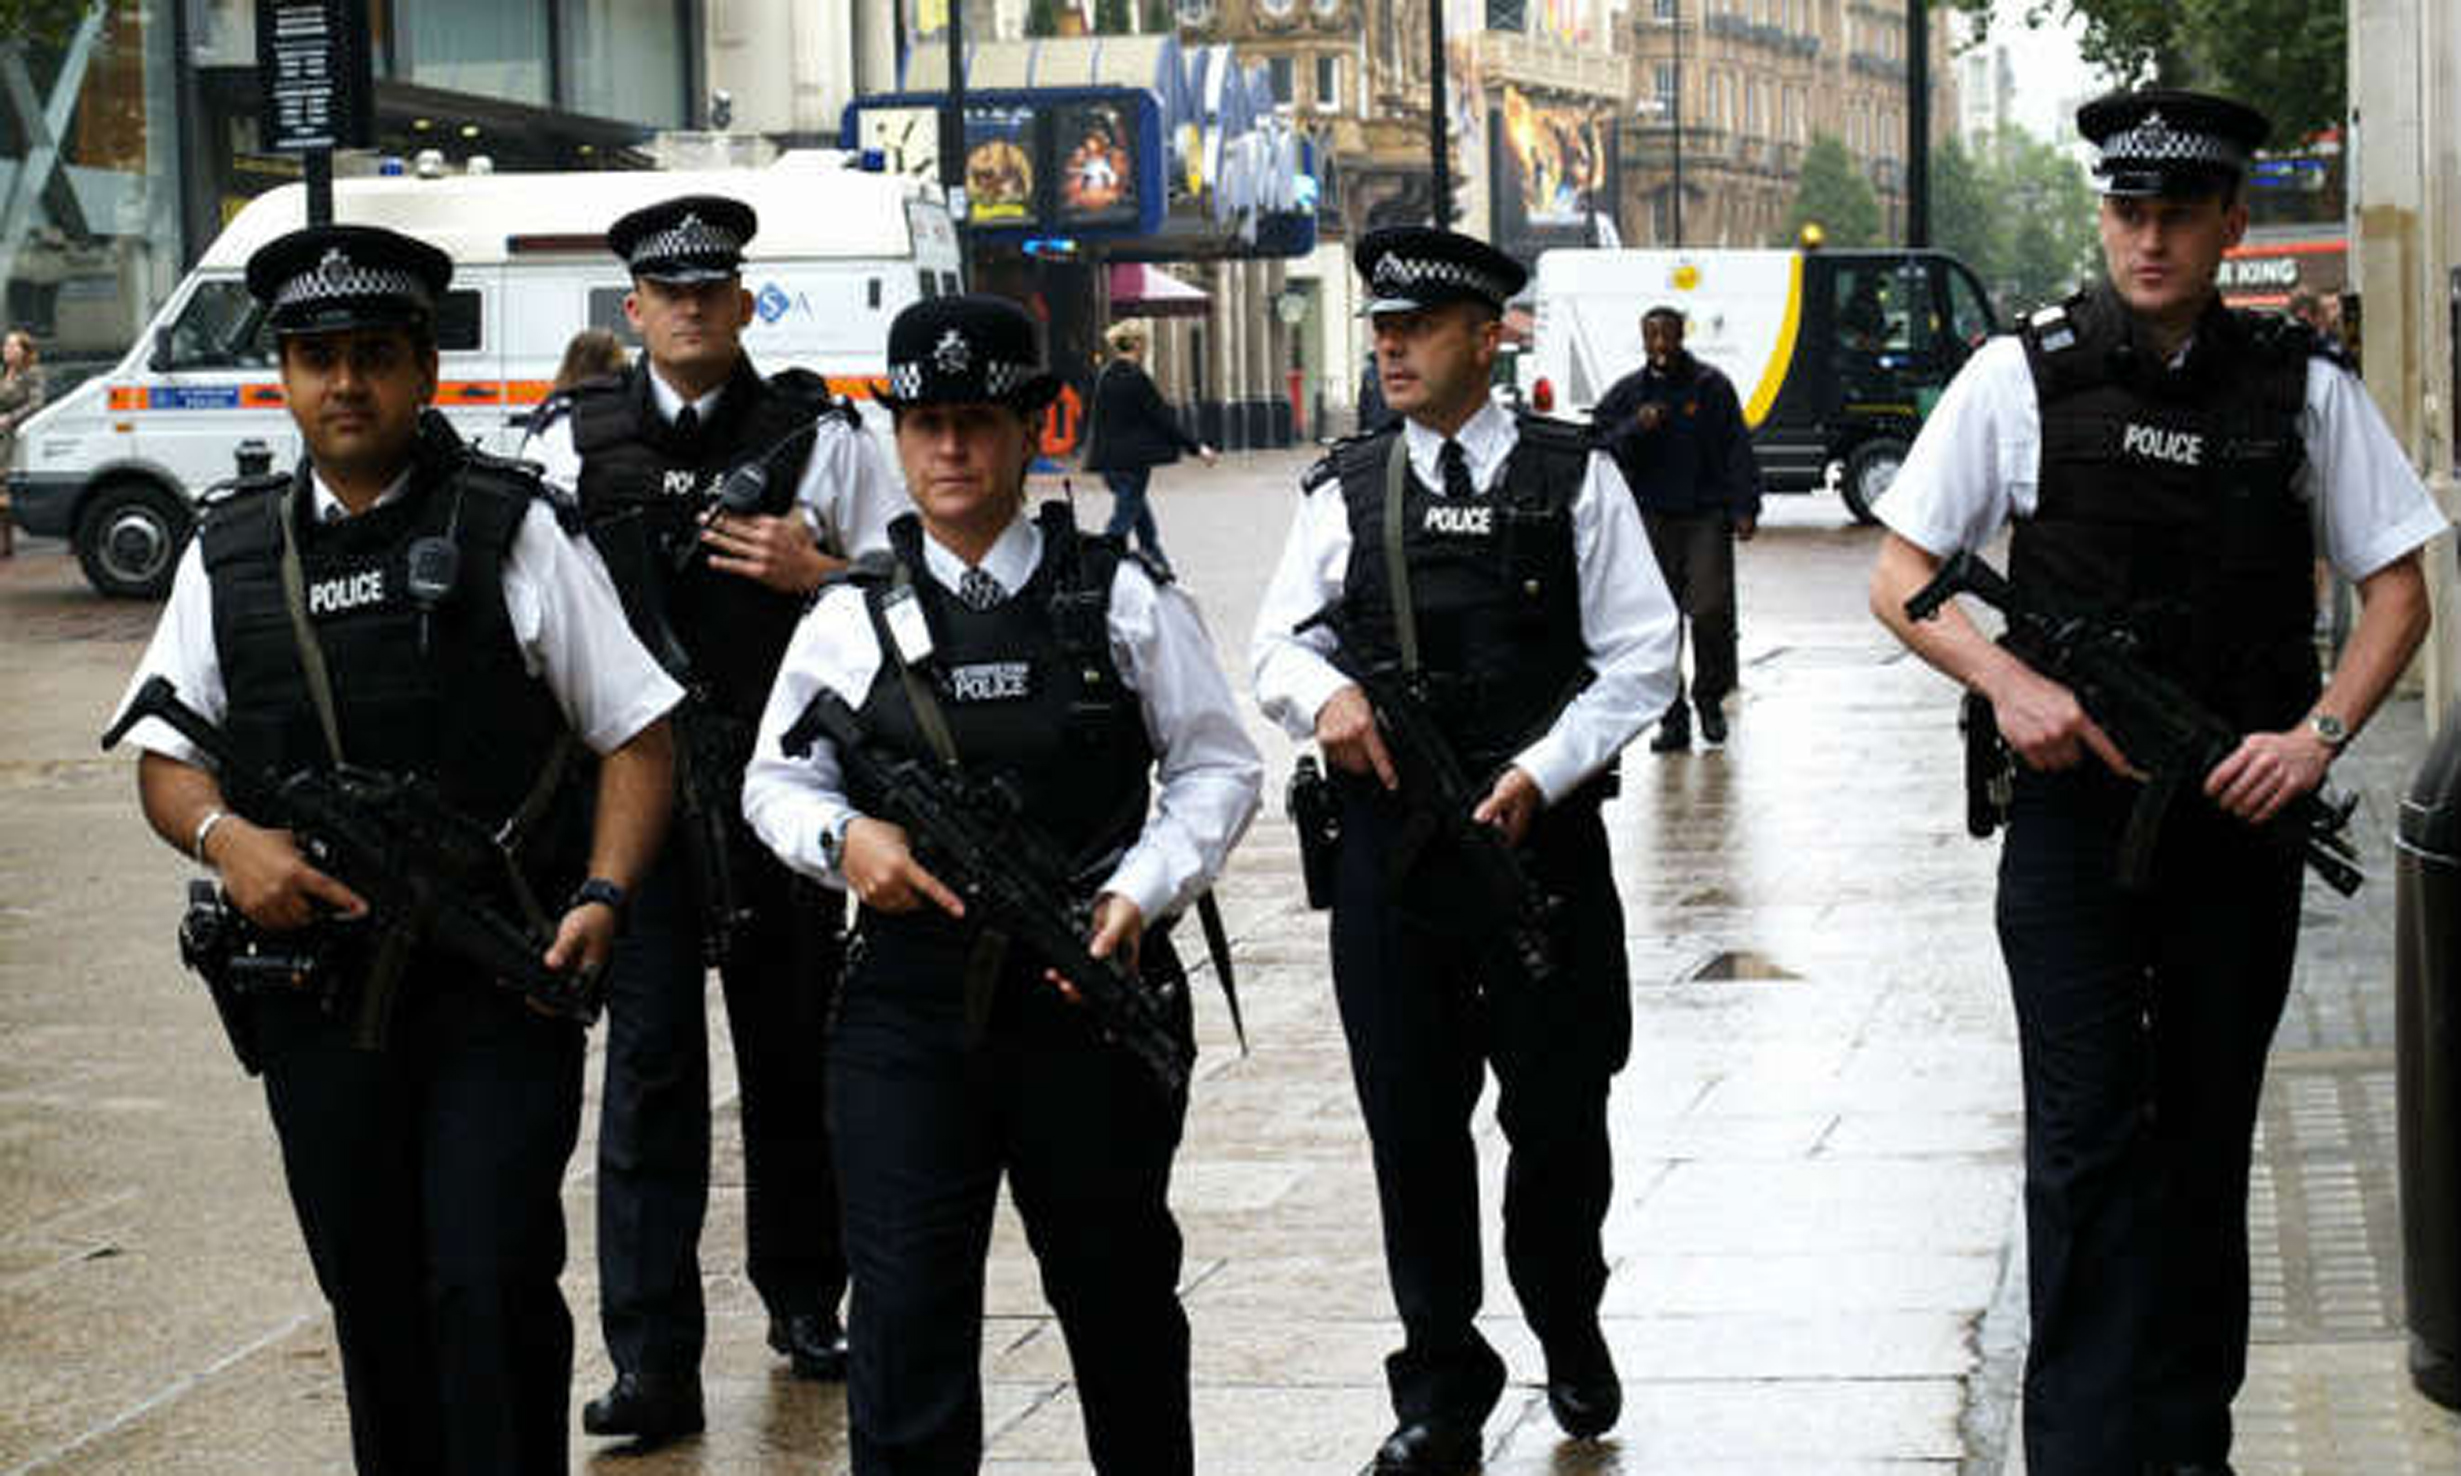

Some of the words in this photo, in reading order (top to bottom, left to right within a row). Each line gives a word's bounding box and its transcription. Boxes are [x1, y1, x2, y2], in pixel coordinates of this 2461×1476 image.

[2237, 257, 2298, 283] KING
[2124, 423, 2202, 465] POLICE
[1424, 506, 1491, 534] POLICE
[310, 571, 382, 614] POLICE
[955, 676, 1027, 700] POLICE
